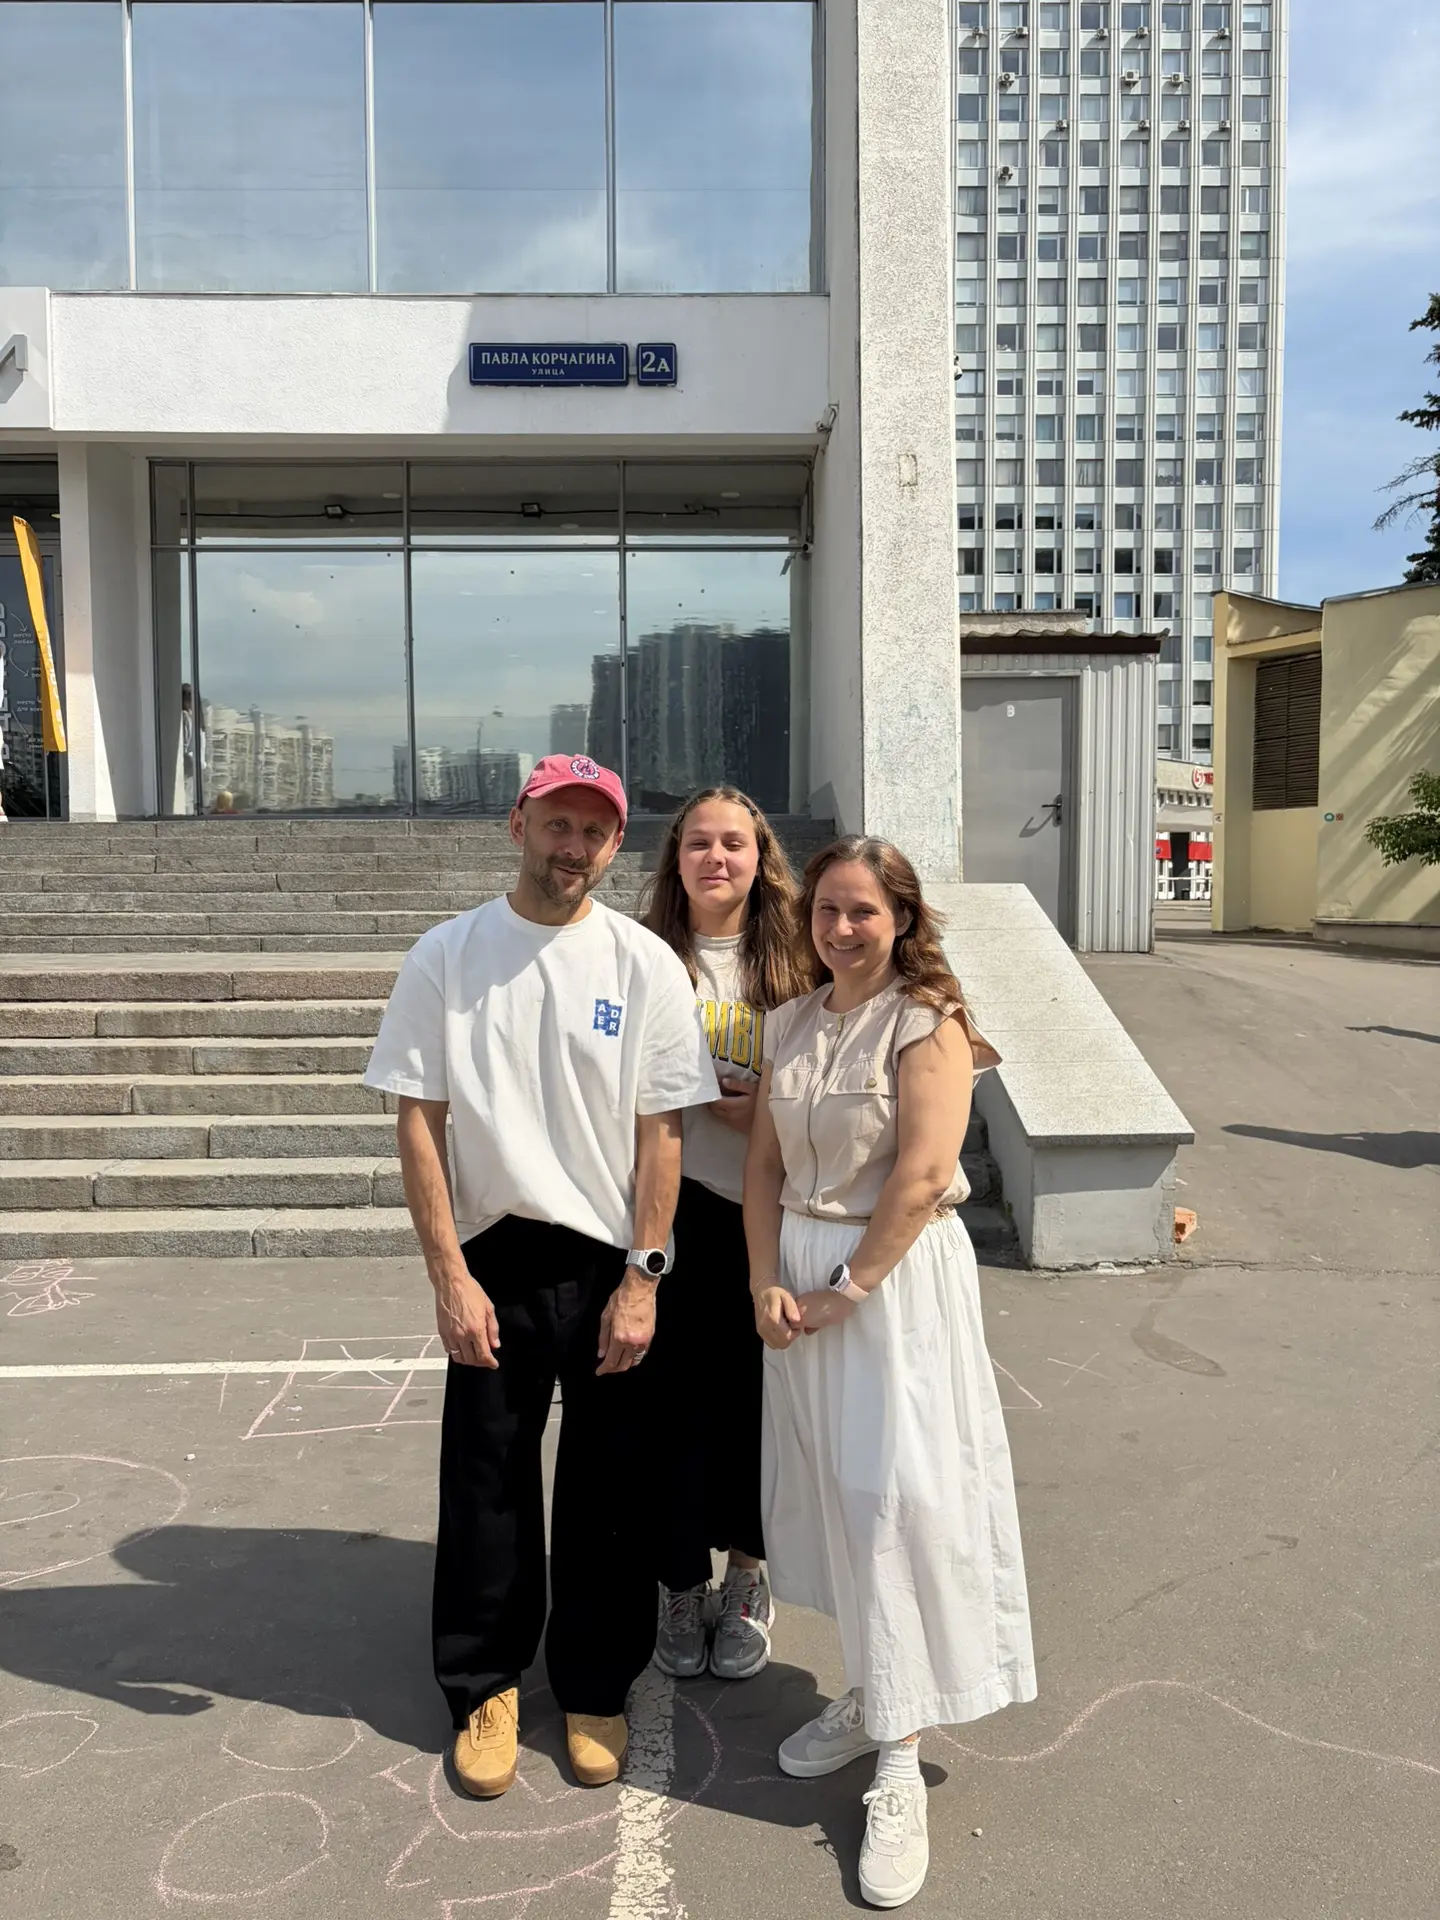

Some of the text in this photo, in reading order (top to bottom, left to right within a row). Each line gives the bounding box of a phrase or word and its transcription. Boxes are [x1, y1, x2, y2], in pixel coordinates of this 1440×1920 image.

[481, 352, 616, 365] ПАВЛА КОРЧАГИНА
[642, 351, 671, 373] 2А
[531, 368, 565, 376] УЛИЦА
[696, 999, 766, 1077] MBI
